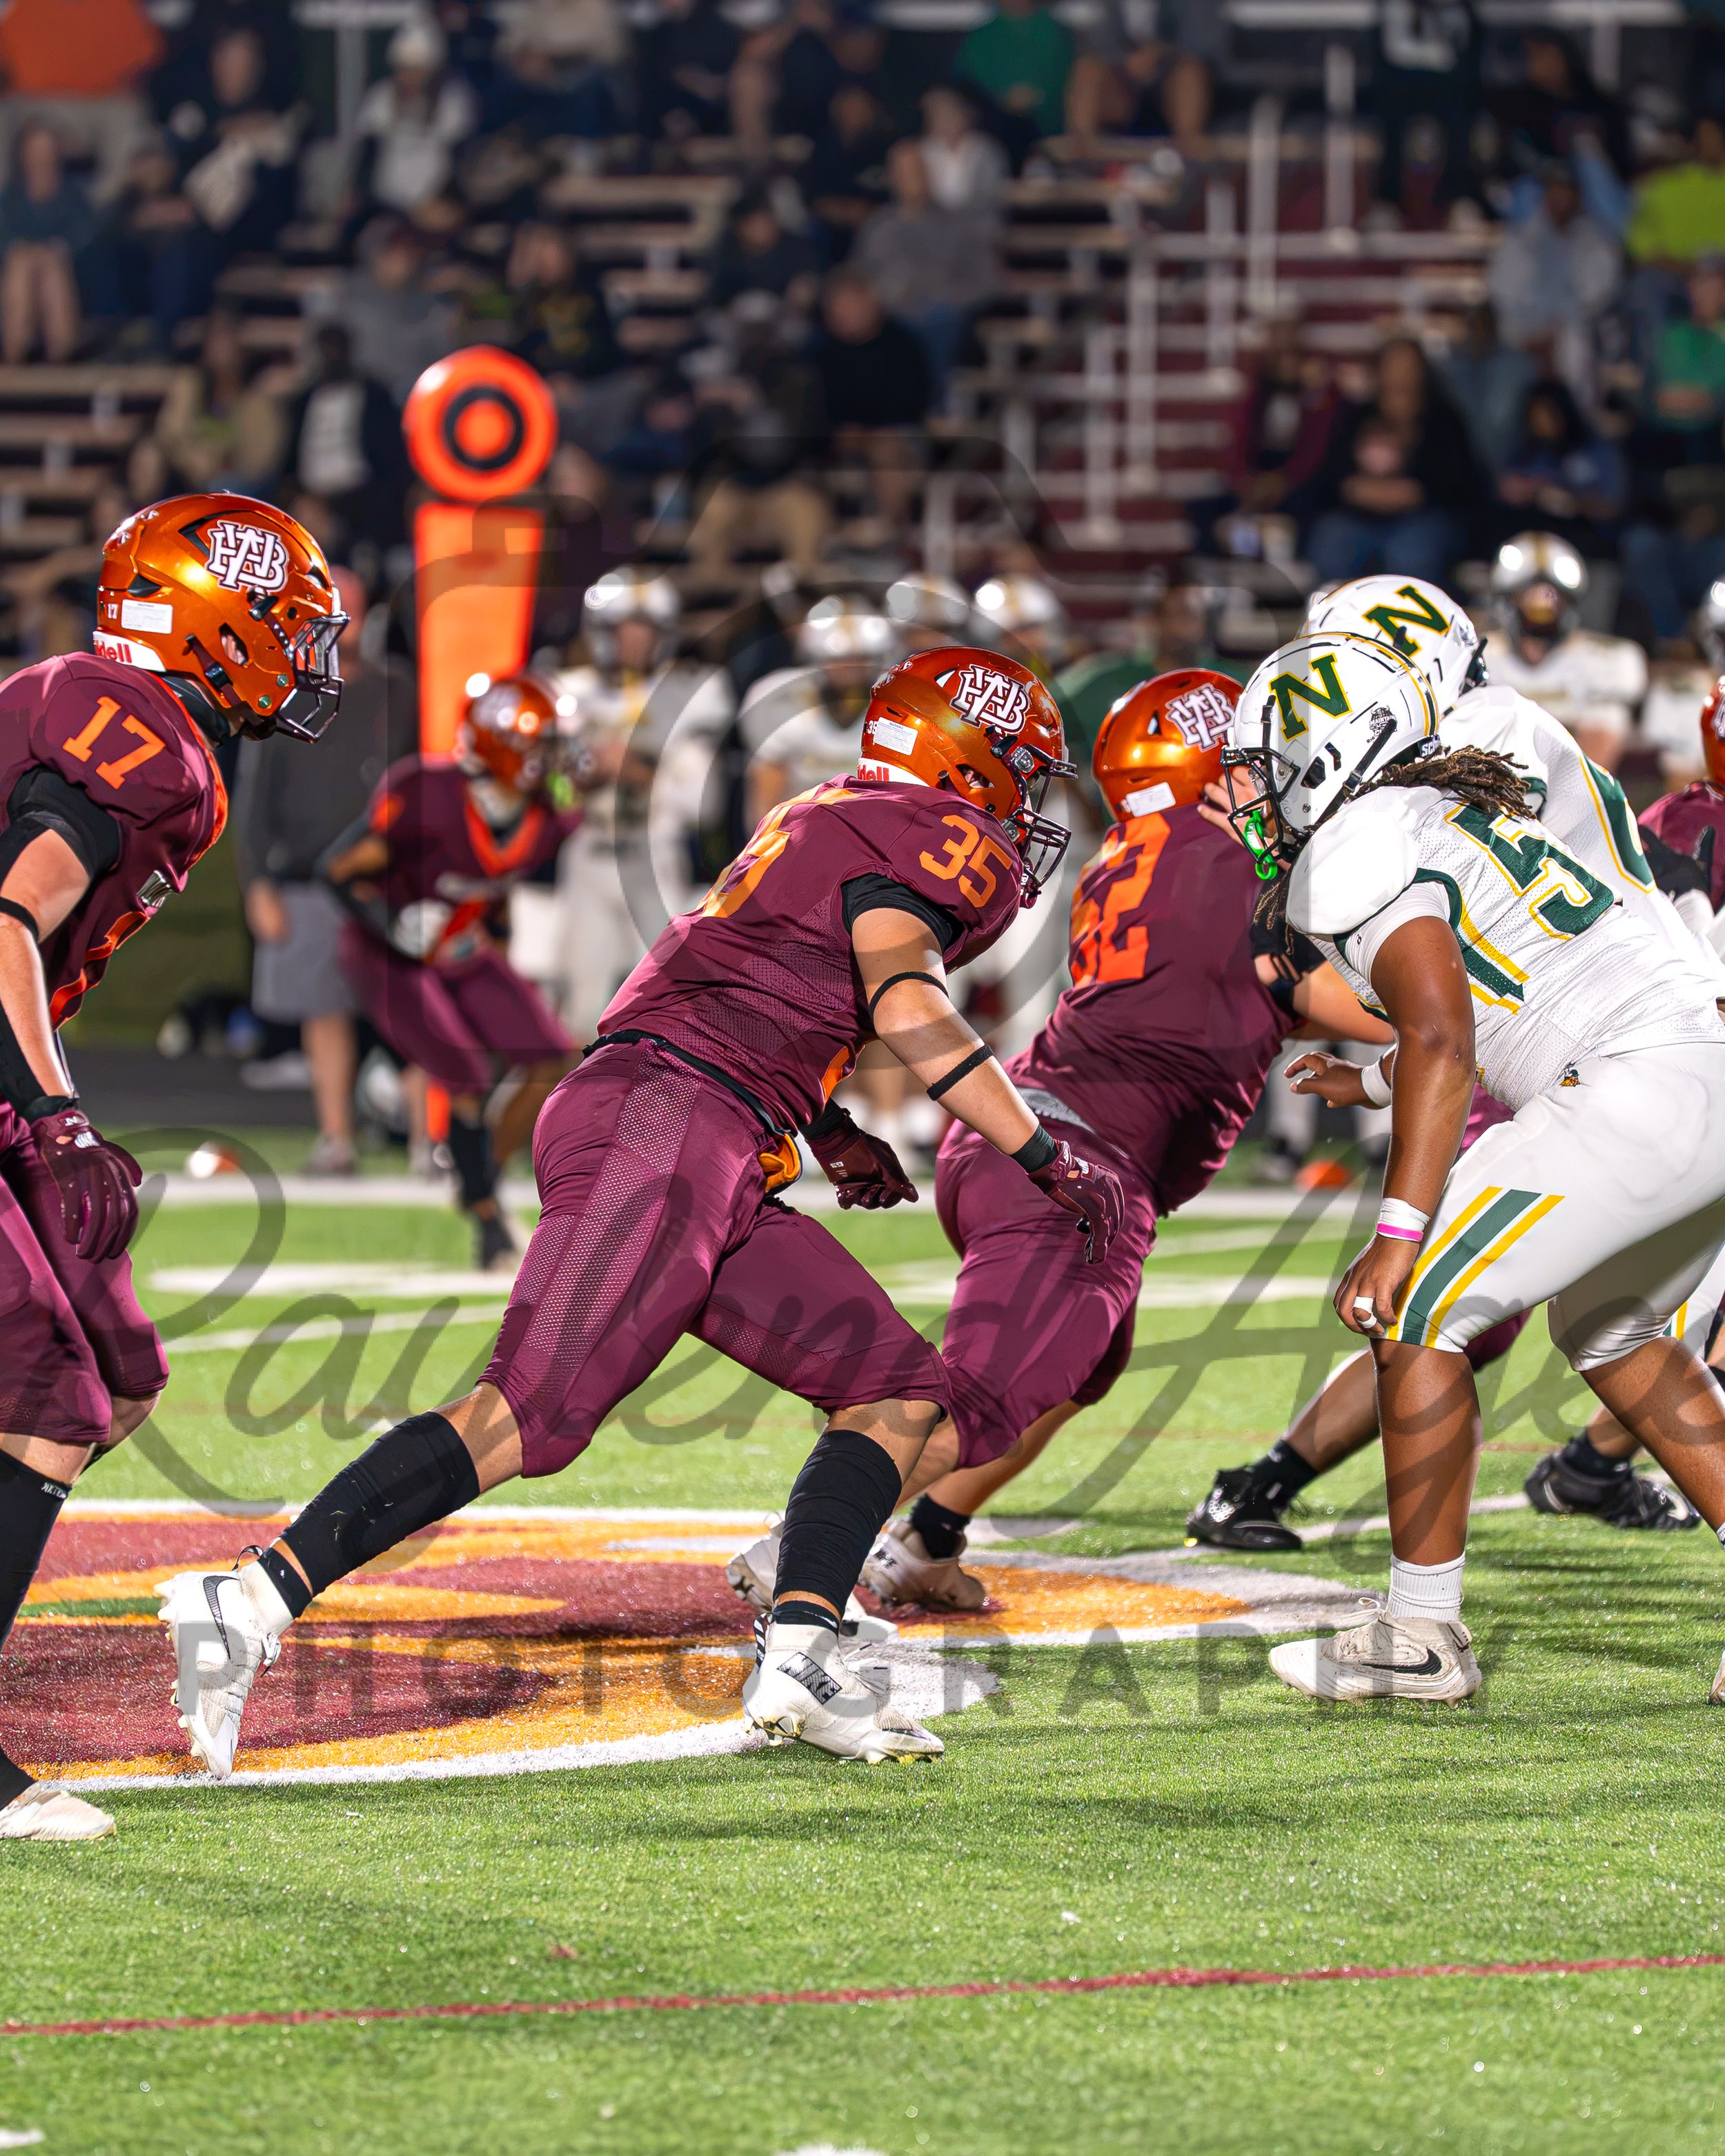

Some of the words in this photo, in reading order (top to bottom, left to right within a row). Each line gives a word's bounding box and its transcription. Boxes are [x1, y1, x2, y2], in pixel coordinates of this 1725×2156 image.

[1362, 584, 1448, 658] N
[1268, 653, 1352, 742] N
[62, 696, 166, 790] 17
[919, 815, 1013, 908] 35
[776, 1652, 843, 1705] NIKE
